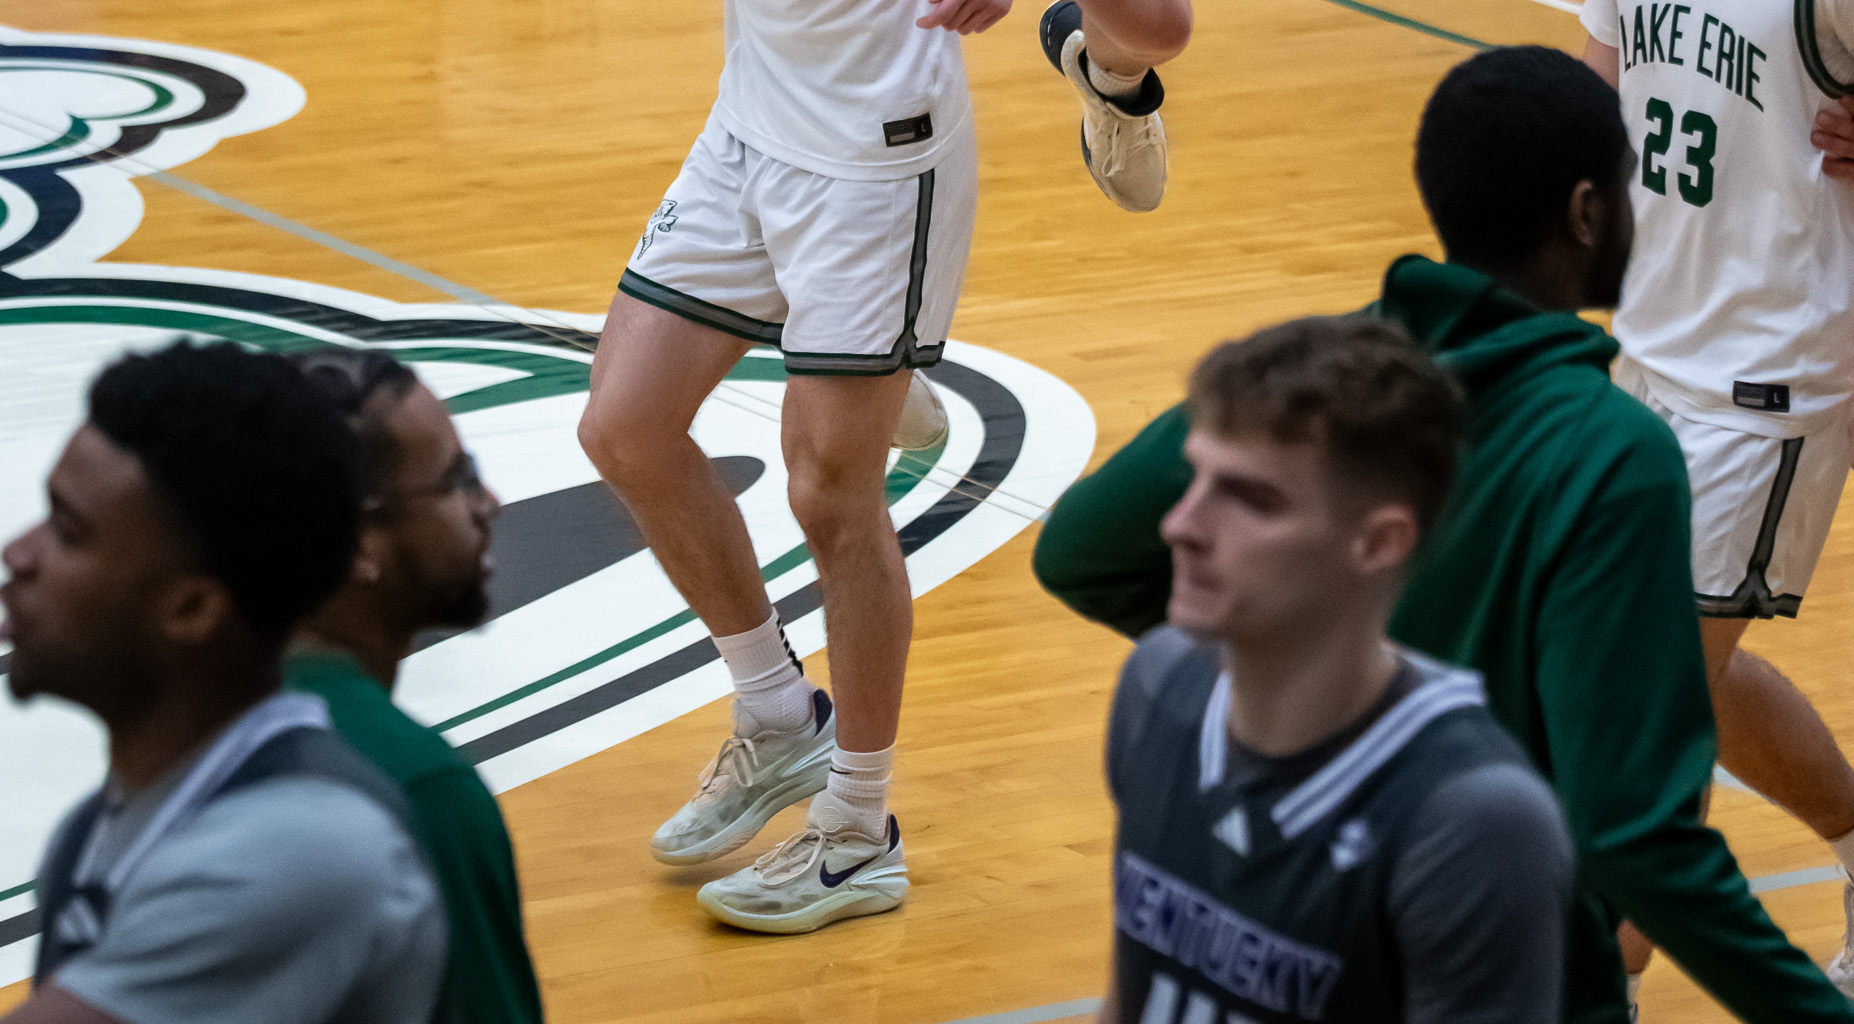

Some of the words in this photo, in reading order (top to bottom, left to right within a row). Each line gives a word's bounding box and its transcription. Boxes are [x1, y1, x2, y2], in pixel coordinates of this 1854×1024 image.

[1619, 3, 1691, 73] LAKE
[1696, 12, 1767, 113] ERIE
[1641, 96, 1718, 208] 23
